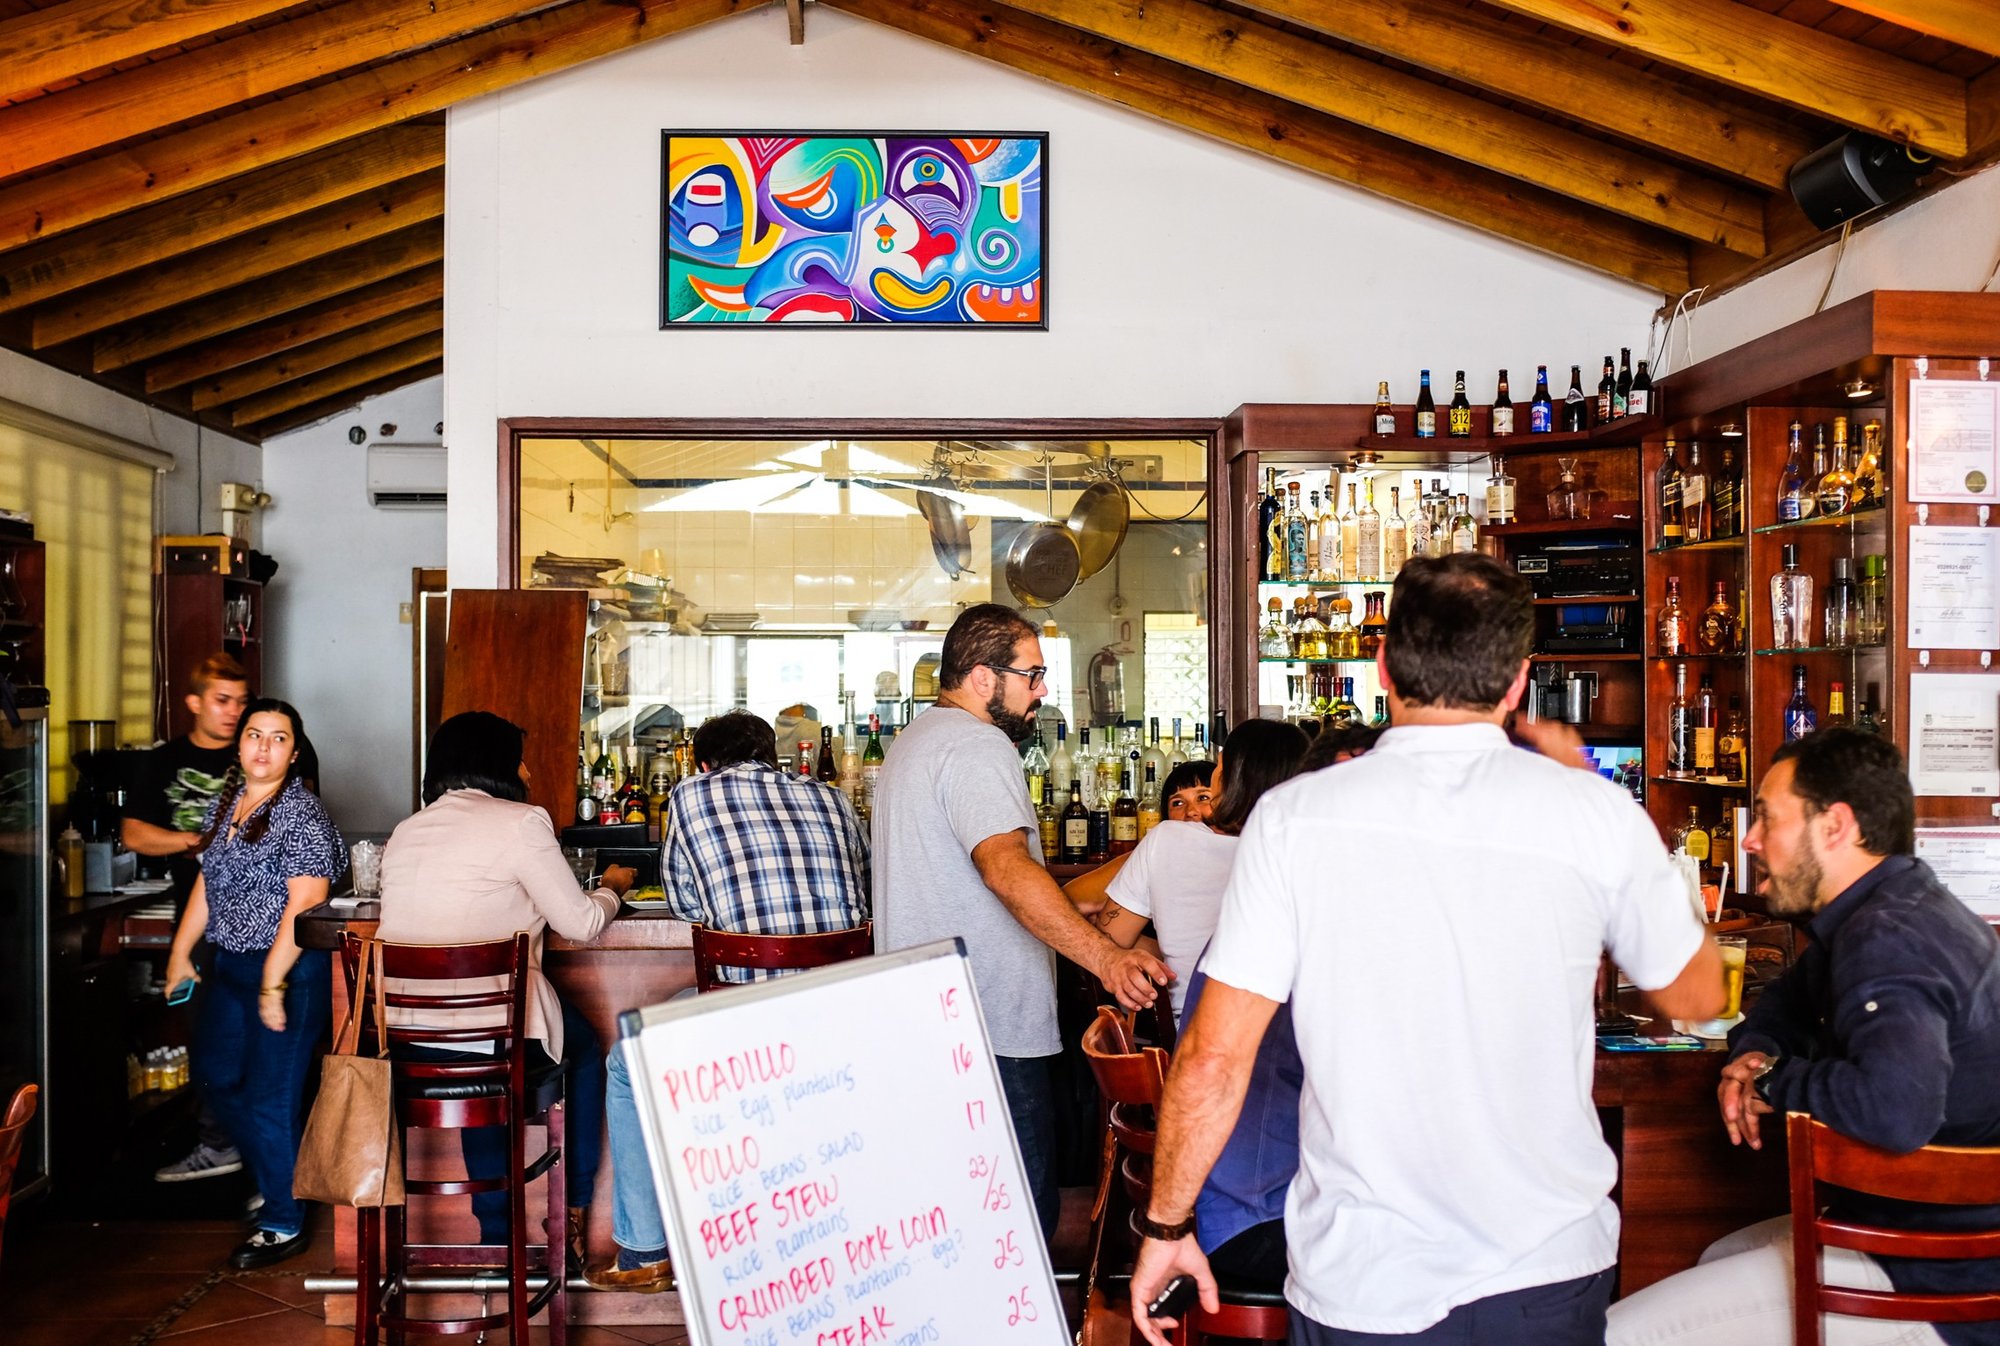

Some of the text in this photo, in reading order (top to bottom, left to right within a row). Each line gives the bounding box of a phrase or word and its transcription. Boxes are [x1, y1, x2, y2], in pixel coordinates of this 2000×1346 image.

[1453, 413, 1468, 424] 312
[940, 988, 959, 1021] 15
[664, 1042, 795, 1112] PICADILLO
[952, 1043, 972, 1074] 16
[783, 1063, 855, 1112] plantains
[967, 1100, 985, 1130] 17
[683, 1136, 760, 1191] POLLO
[760, 1153, 807, 1190] BEANS
[817, 1132, 864, 1165] SALAD
[700, 1174, 839, 1260] BEEF STEW
[994, 1230, 1024, 1269] 25
[719, 1257, 835, 1332] CRUMBED
[787, 1294, 835, 1338] BEANS
[1008, 1285, 1037, 1326] 25
